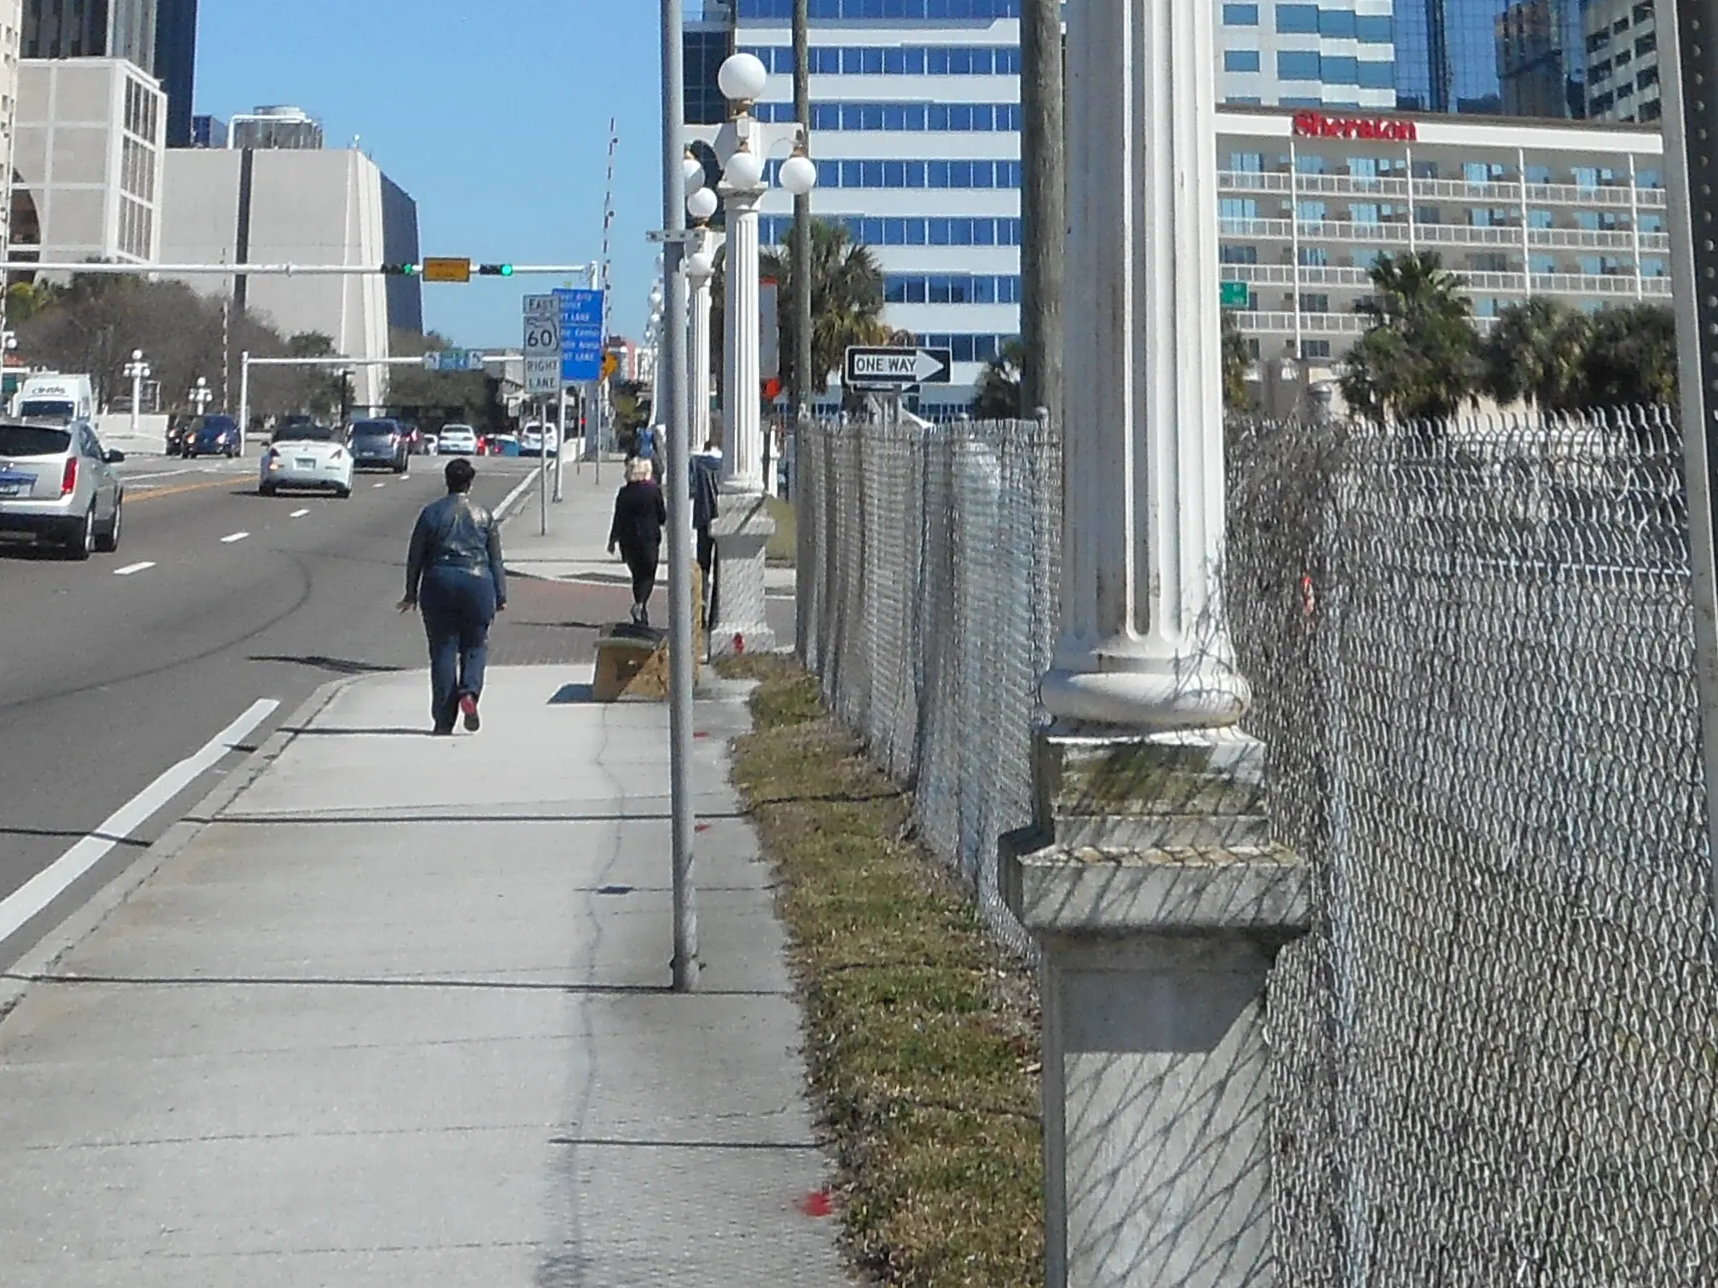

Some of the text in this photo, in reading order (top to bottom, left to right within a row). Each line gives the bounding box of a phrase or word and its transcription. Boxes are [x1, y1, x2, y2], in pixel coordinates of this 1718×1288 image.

[1295, 109, 1417, 141] Sheraton
[529, 299, 554, 311] EAST
[527, 329, 553, 347] 60
[527, 359, 558, 372] RIGHT
[856, 358, 917, 372] ONE WAY
[529, 377, 555, 388] LANE
